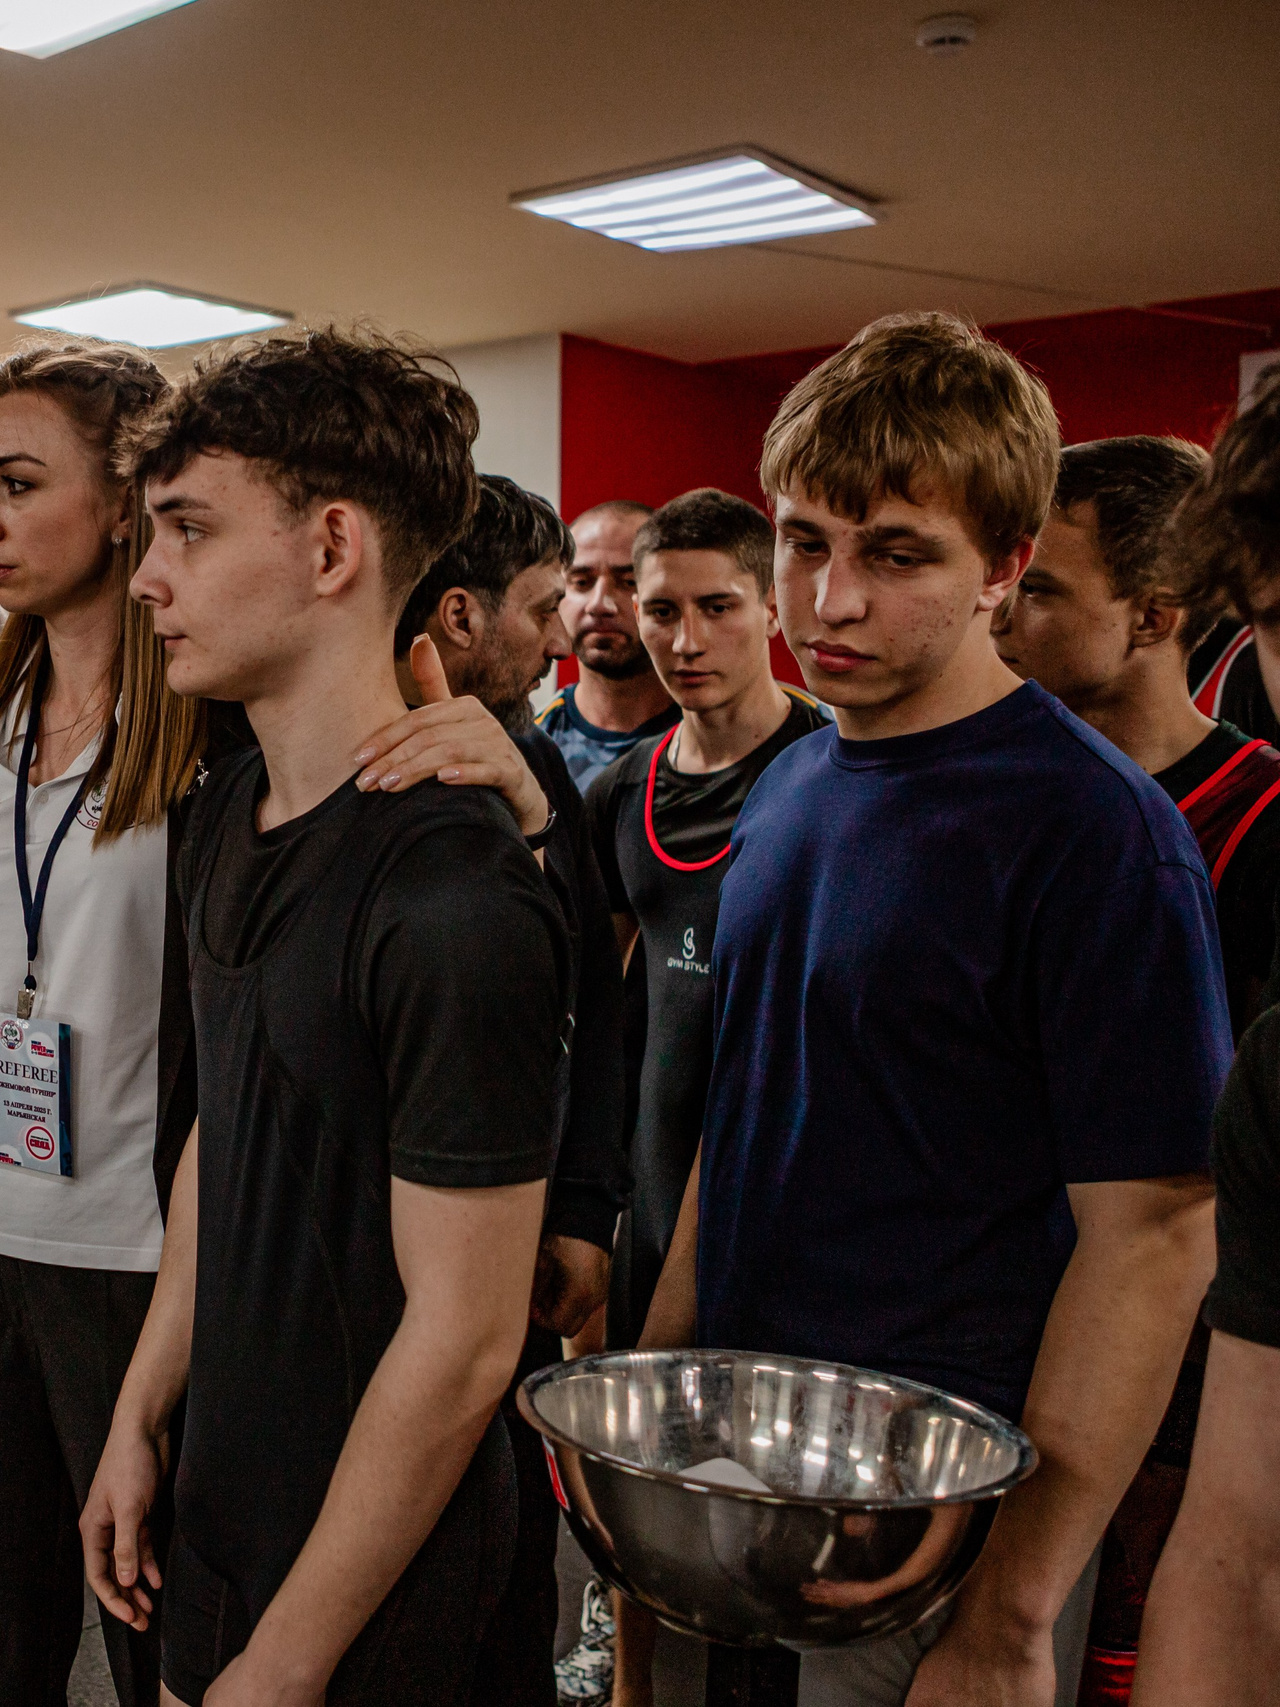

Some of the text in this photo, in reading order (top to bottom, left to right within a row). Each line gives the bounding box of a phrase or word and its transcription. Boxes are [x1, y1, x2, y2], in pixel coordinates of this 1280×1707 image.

[667, 957, 710, 974] GYM STYLE
[10, 1101, 33, 1111] АПРЕЛЯ
[7, 1109, 46, 1123] МАРЬЯНСКАЯ
